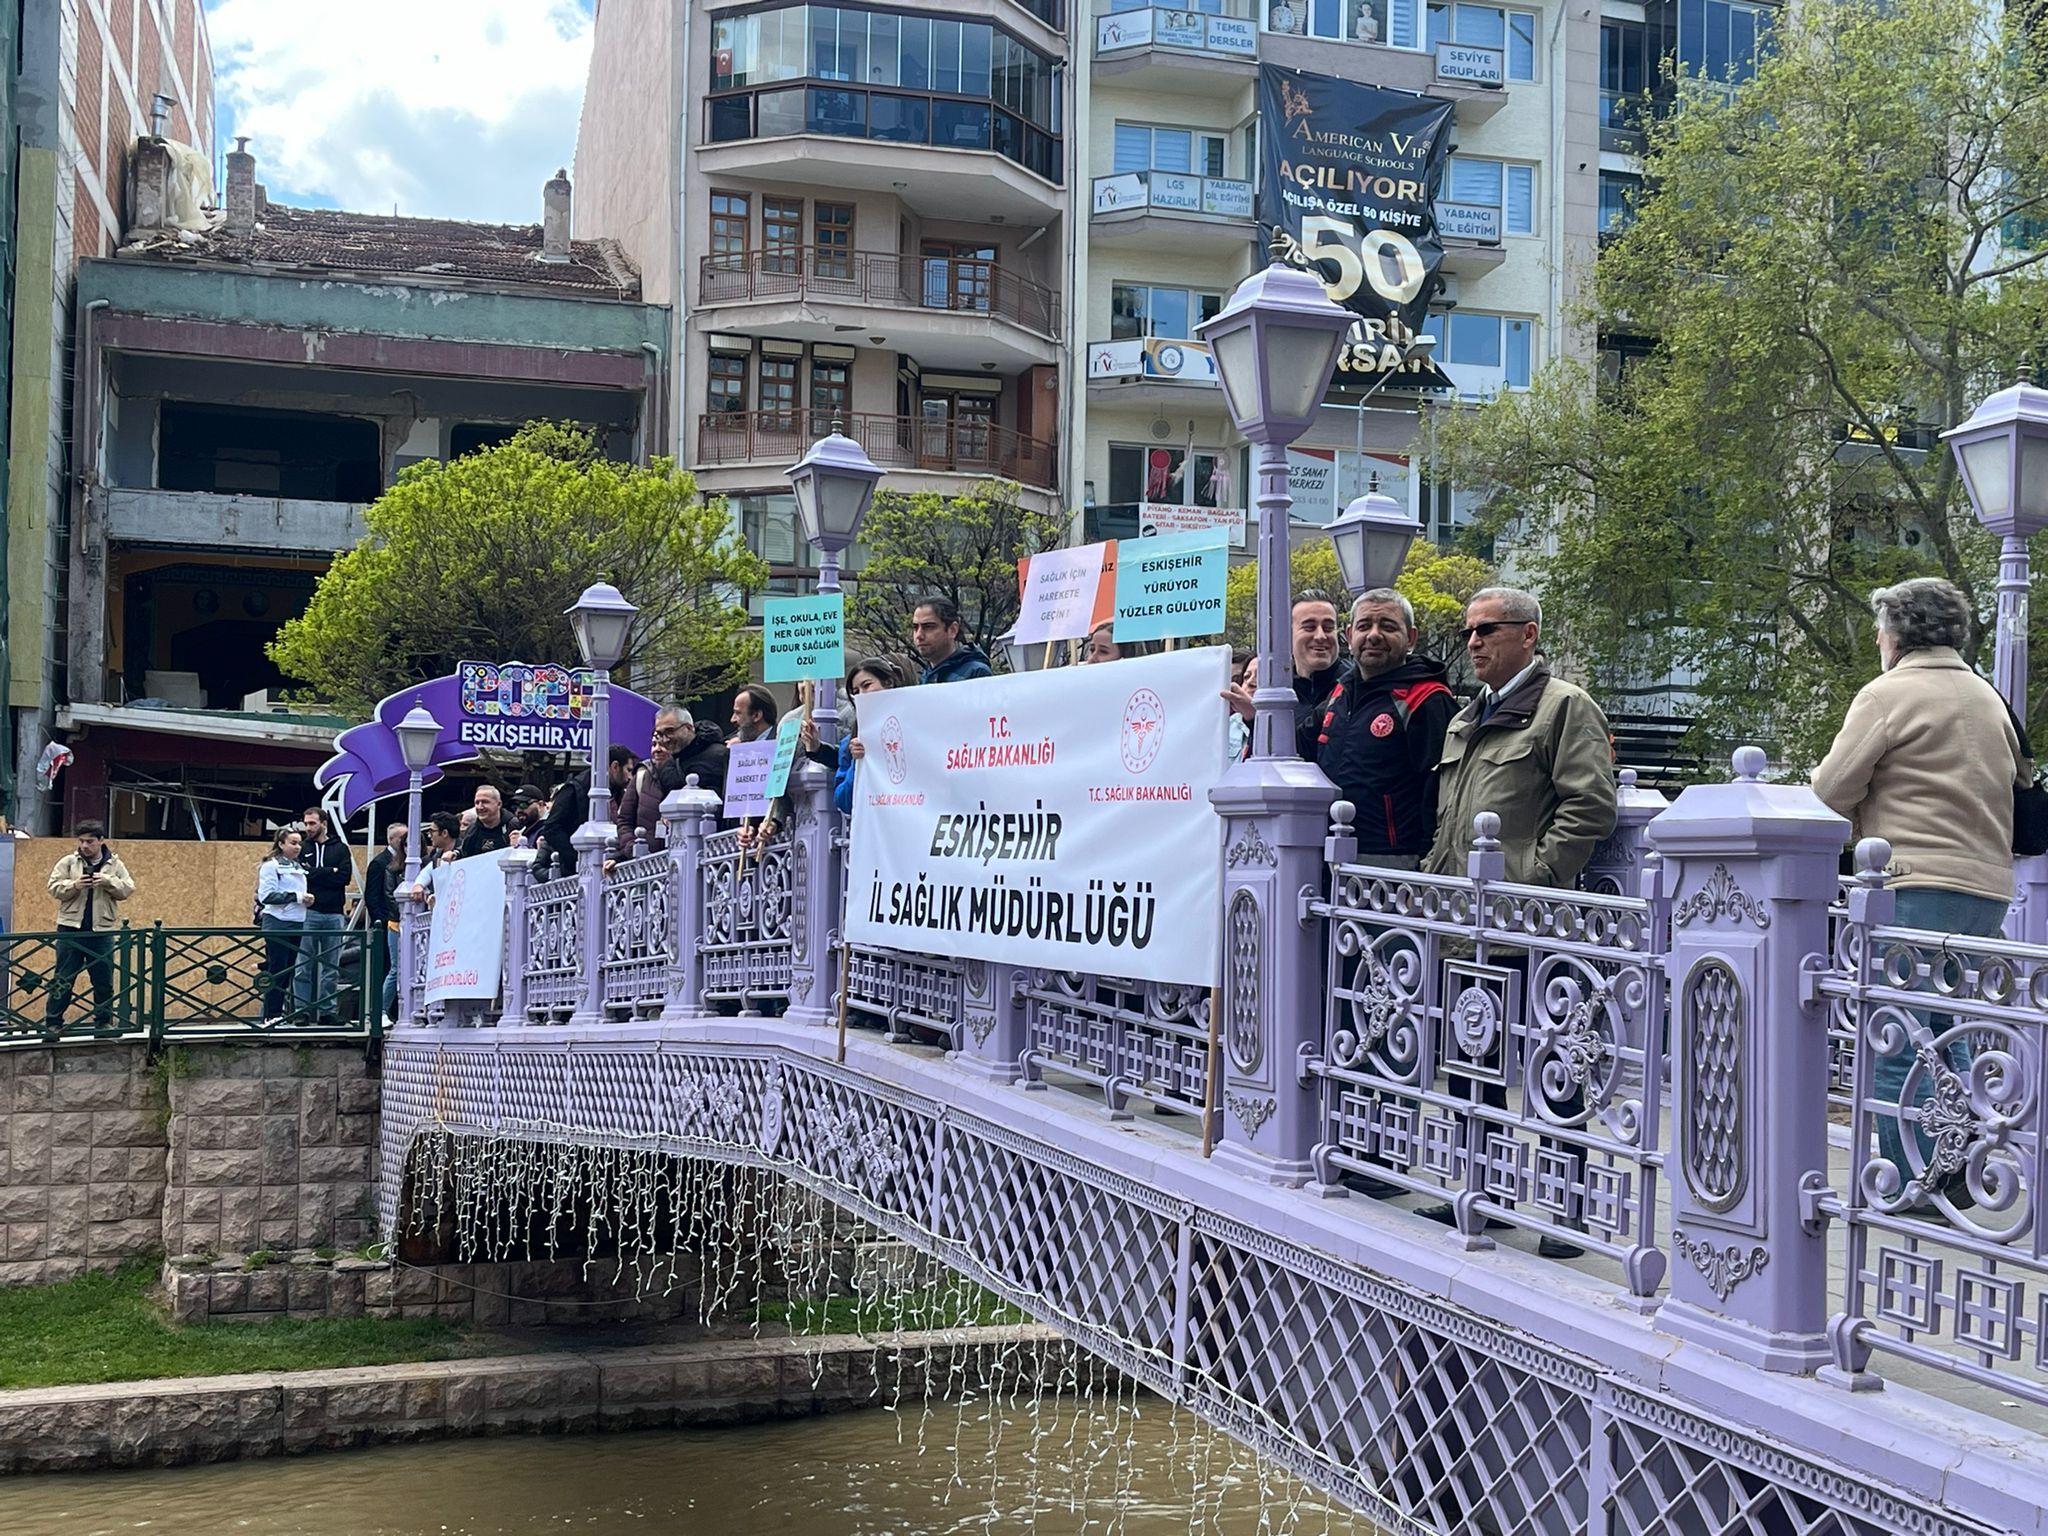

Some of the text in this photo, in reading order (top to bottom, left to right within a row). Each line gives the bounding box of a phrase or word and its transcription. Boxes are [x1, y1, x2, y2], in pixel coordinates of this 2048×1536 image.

[1216, 22, 1248, 34] TEMEL
[1210, 35, 1254, 48] DERSLER
[1450, 51, 1491, 64] SEVİYE
[1441, 64, 1500, 80] GRUPLARI
[1302, 146, 1415, 171] LANGUAGE SCHOOLS
[1166, 179, 1185, 190] LGS
[1209, 180, 1246, 191] YABANCI
[1280, 160, 1425, 203] AÇILIYOR!
[1153, 194, 1198, 208] HAZIRLIK
[1205, 191, 1250, 204] DİL EĞİTİMİ
[1282, 189, 1422, 227] AÇILIŞA ÖZEL 50 KİŞİYE
[1444, 208, 1491, 221] YABANCI
[1438, 221, 1496, 236] DİL EĞİTİMİ
[1301, 467, 1328, 478] SANAT
[1141, 555, 1203, 573] ESKİŞEHİR
[1040, 571, 1067, 584] SAĞLIK
[1069, 567, 1087, 581] İÇİN
[1144, 578, 1198, 594] YÜRÜYOR
[1038, 588, 1080, 602] HAREKETE
[1119, 598, 1221, 619] YÜZLER GÜLÜYOR
[790, 613, 821, 623] OKULA,
[823, 611, 838, 621] EVE
[774, 625, 836, 639] HER GÜN YÜRÜ
[770, 640, 840, 653] BUDUR SAĞLIĞIN
[461, 719, 564, 746] ESKİŞEHİR
[989, 716, 1012, 738] T.C.
[946, 736, 1055, 770] SAĞLIK BAKANLIĞI
[1089, 782, 1192, 802] T.C. SAĞLIK BAKANLIĞI
[930, 799, 1062, 866] ESKİŞEHİR
[868, 869, 1156, 950] İL SAĞLIK MÜDÜRLÜĞÜ
